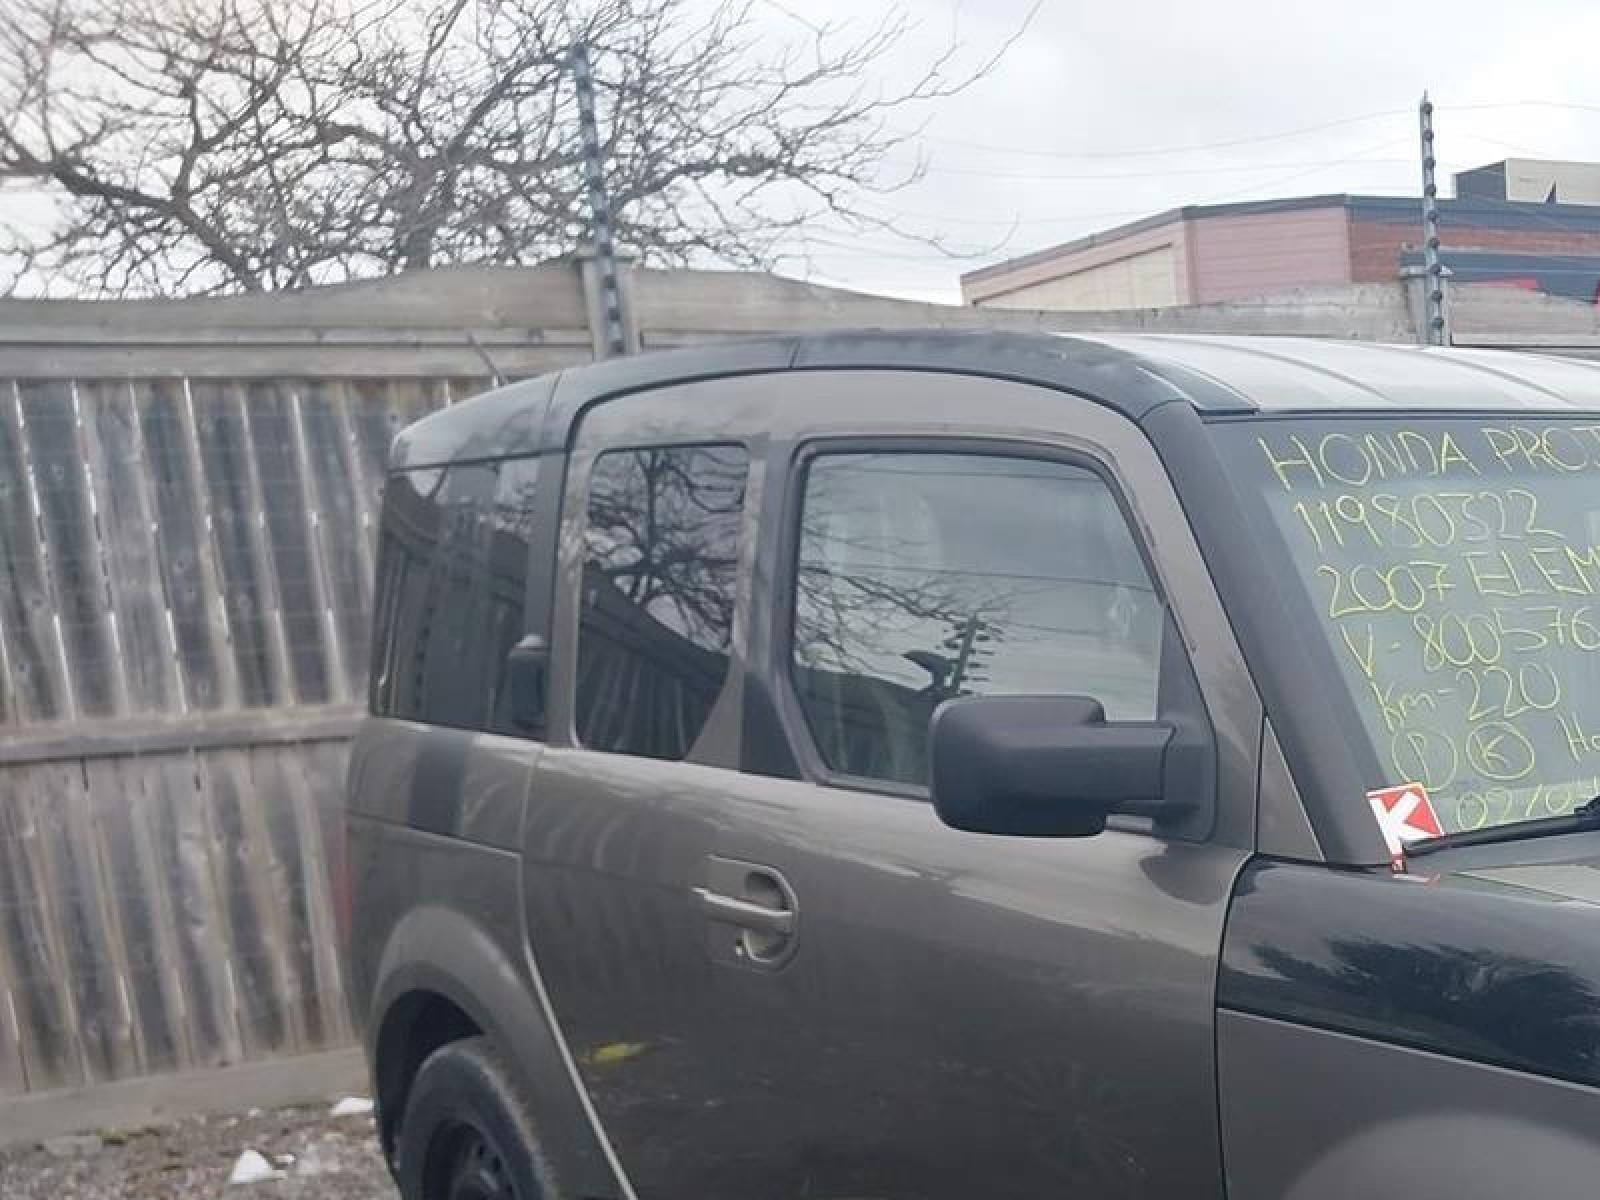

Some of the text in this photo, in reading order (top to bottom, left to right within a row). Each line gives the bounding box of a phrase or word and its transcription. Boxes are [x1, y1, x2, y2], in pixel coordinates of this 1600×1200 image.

[1258, 431, 1483, 491] HONDA
[1293, 489, 1565, 552] 11980322
[1315, 559, 1457, 619] 2007
